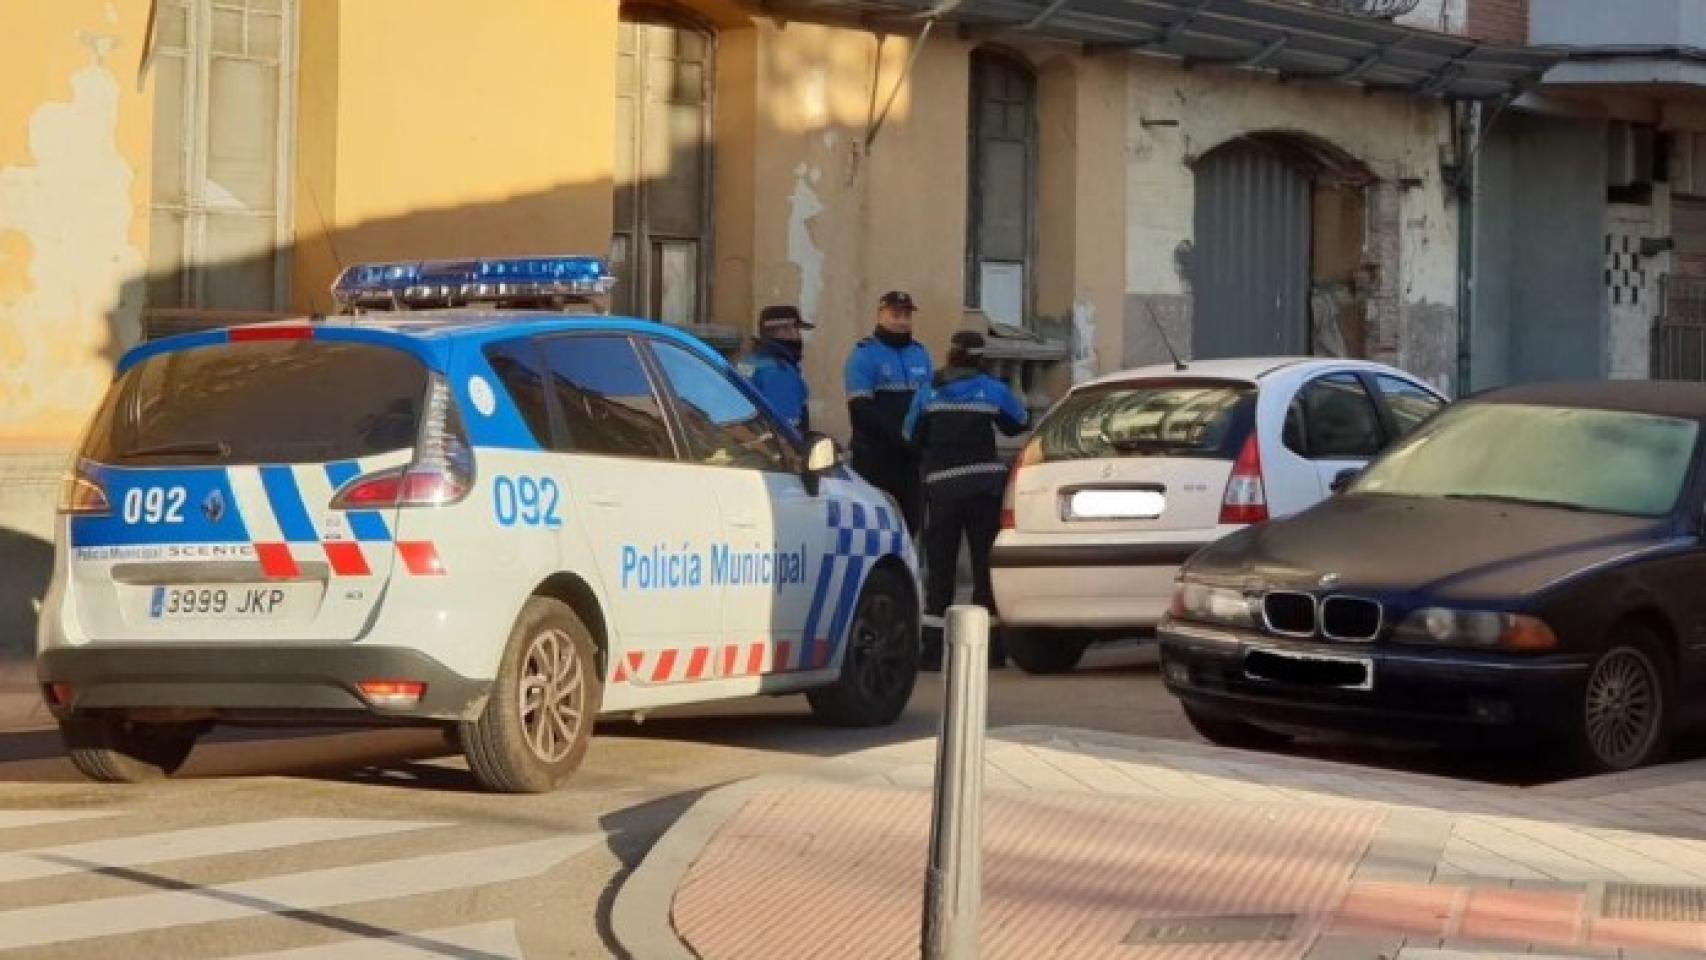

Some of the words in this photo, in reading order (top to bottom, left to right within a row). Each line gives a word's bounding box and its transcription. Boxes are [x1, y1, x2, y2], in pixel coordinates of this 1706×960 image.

[124, 486, 187, 525] 092
[495, 475, 562, 525] 092
[167, 545, 252, 557] SCENIC
[622, 541, 700, 589] Policía
[710, 540, 806, 595] Municipal
[167, 589, 228, 613] 3999
[237, 588, 285, 614] JKP
